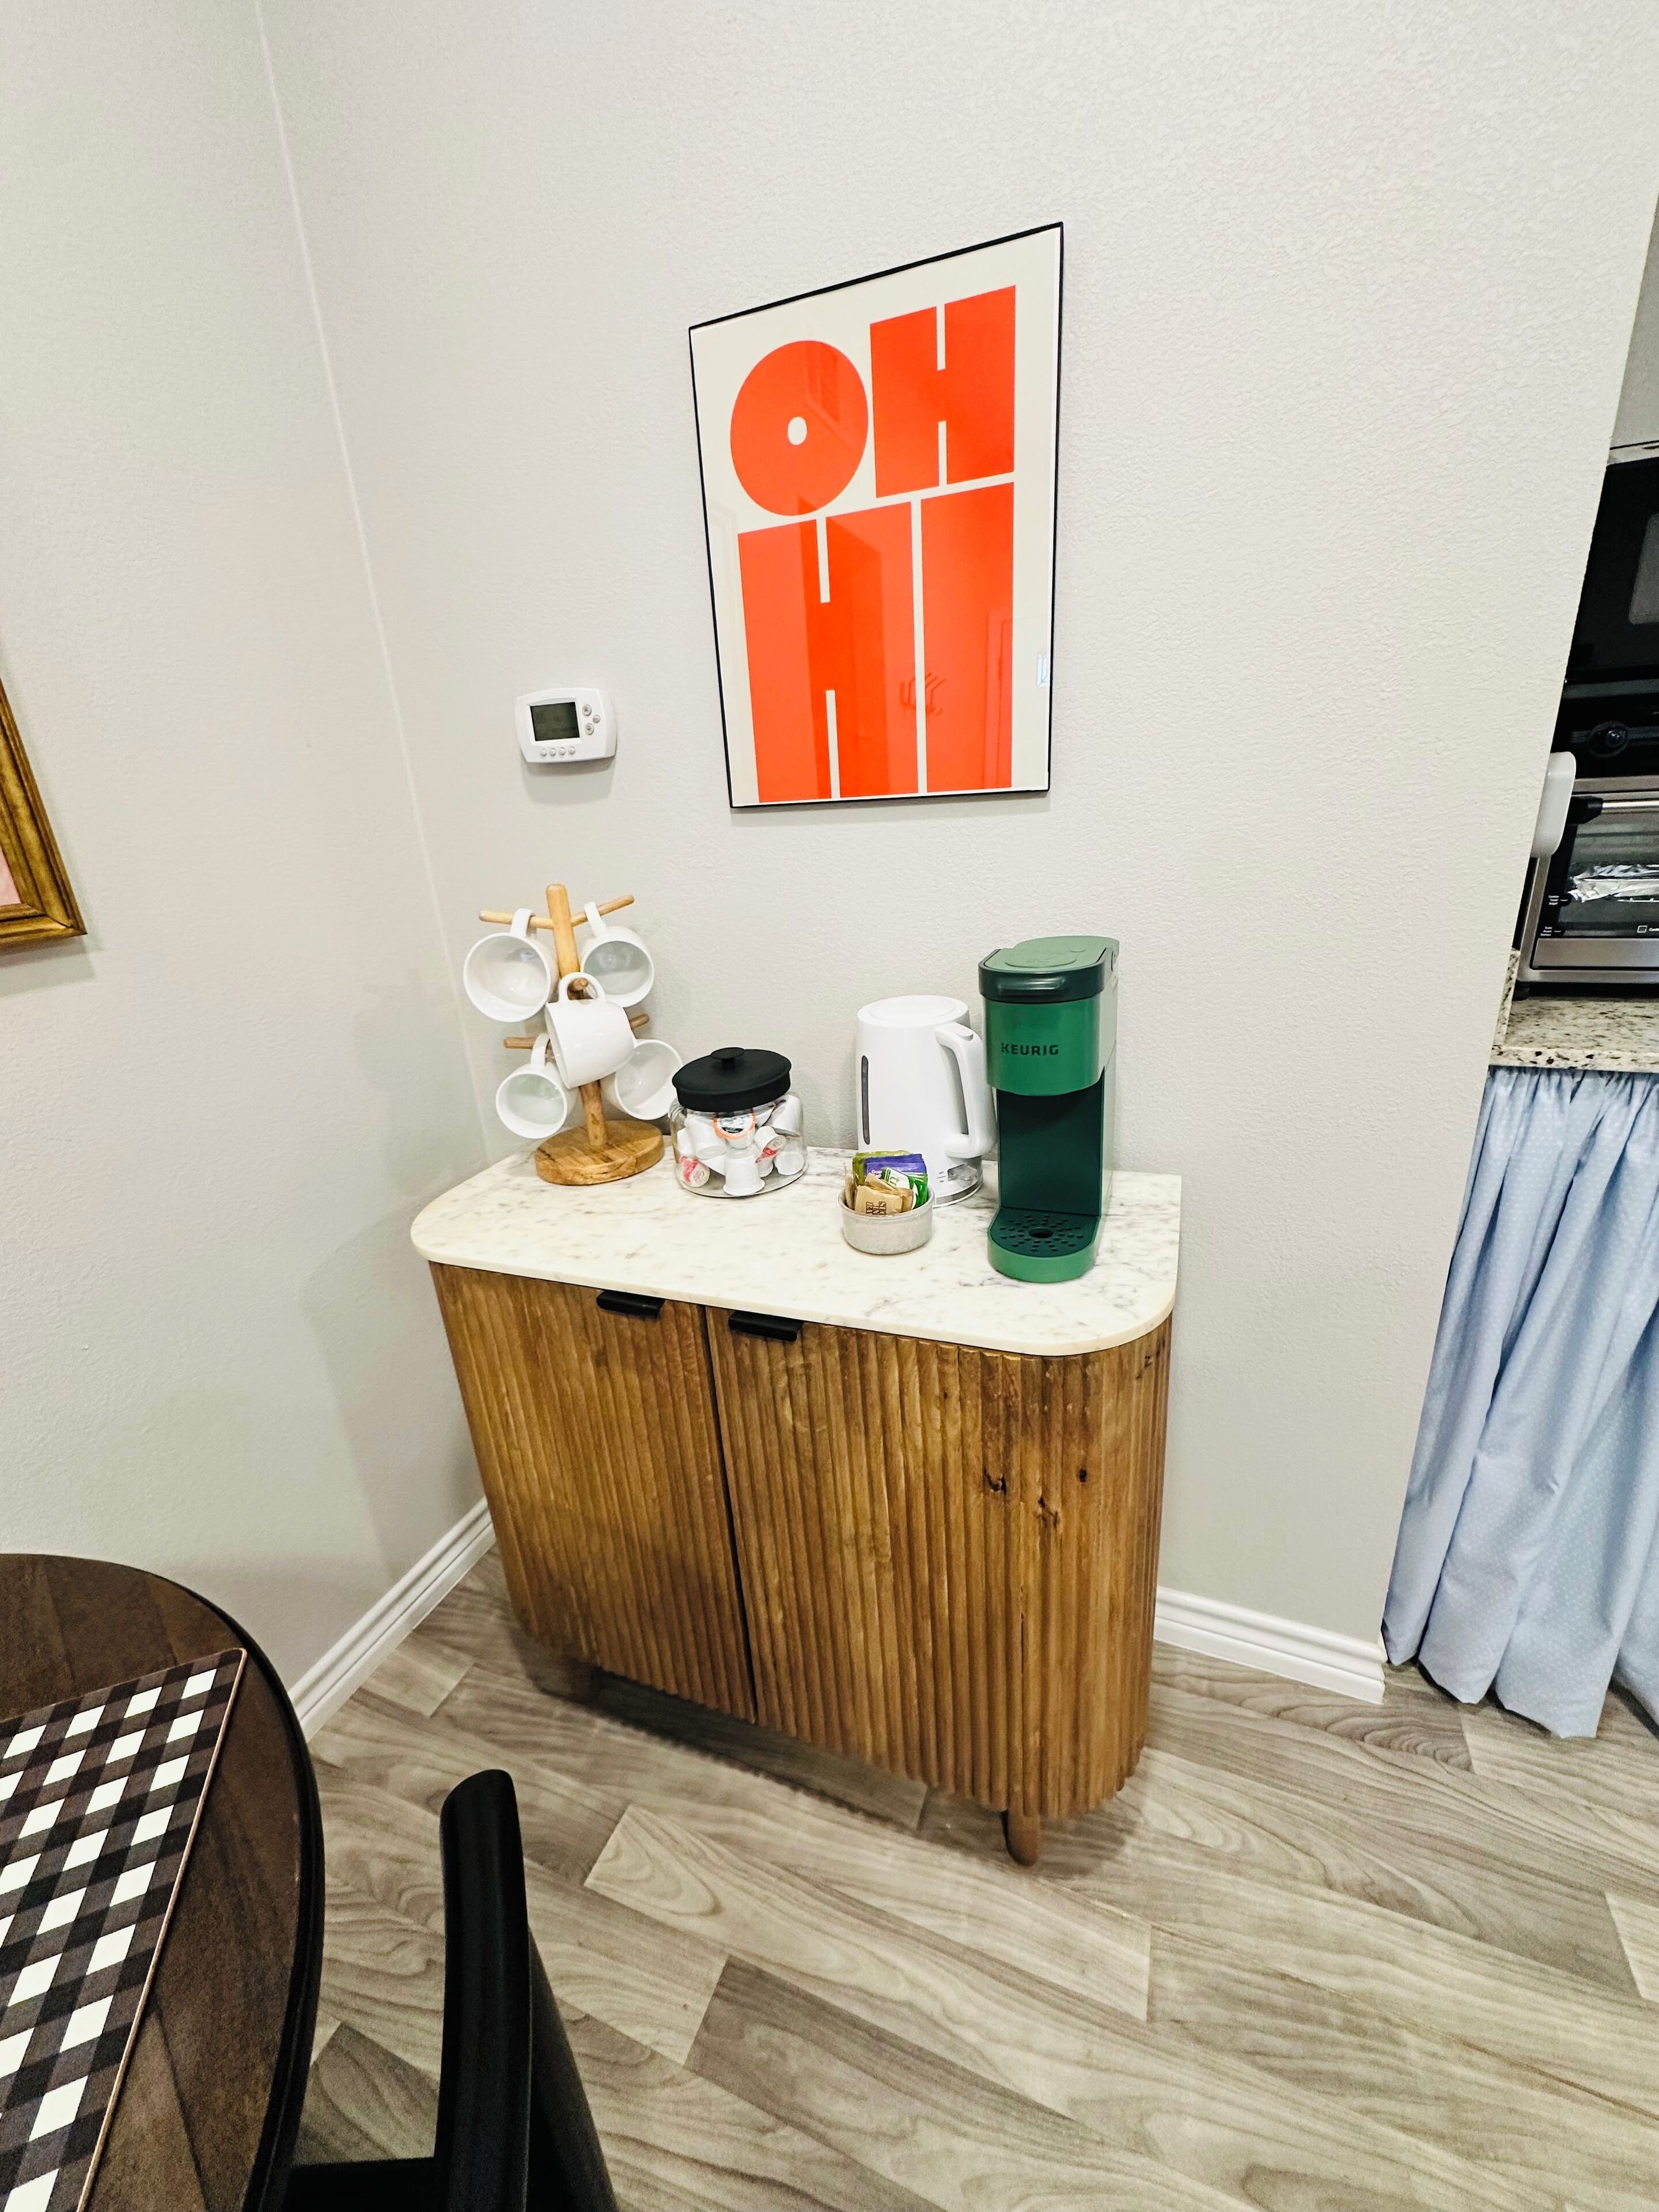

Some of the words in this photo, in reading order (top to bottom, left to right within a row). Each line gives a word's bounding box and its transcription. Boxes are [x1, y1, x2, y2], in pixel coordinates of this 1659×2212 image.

[730, 285, 1016, 516] OH
[737, 482, 1015, 804] HI
[1001, 1042, 1059, 1056] KEURIG
